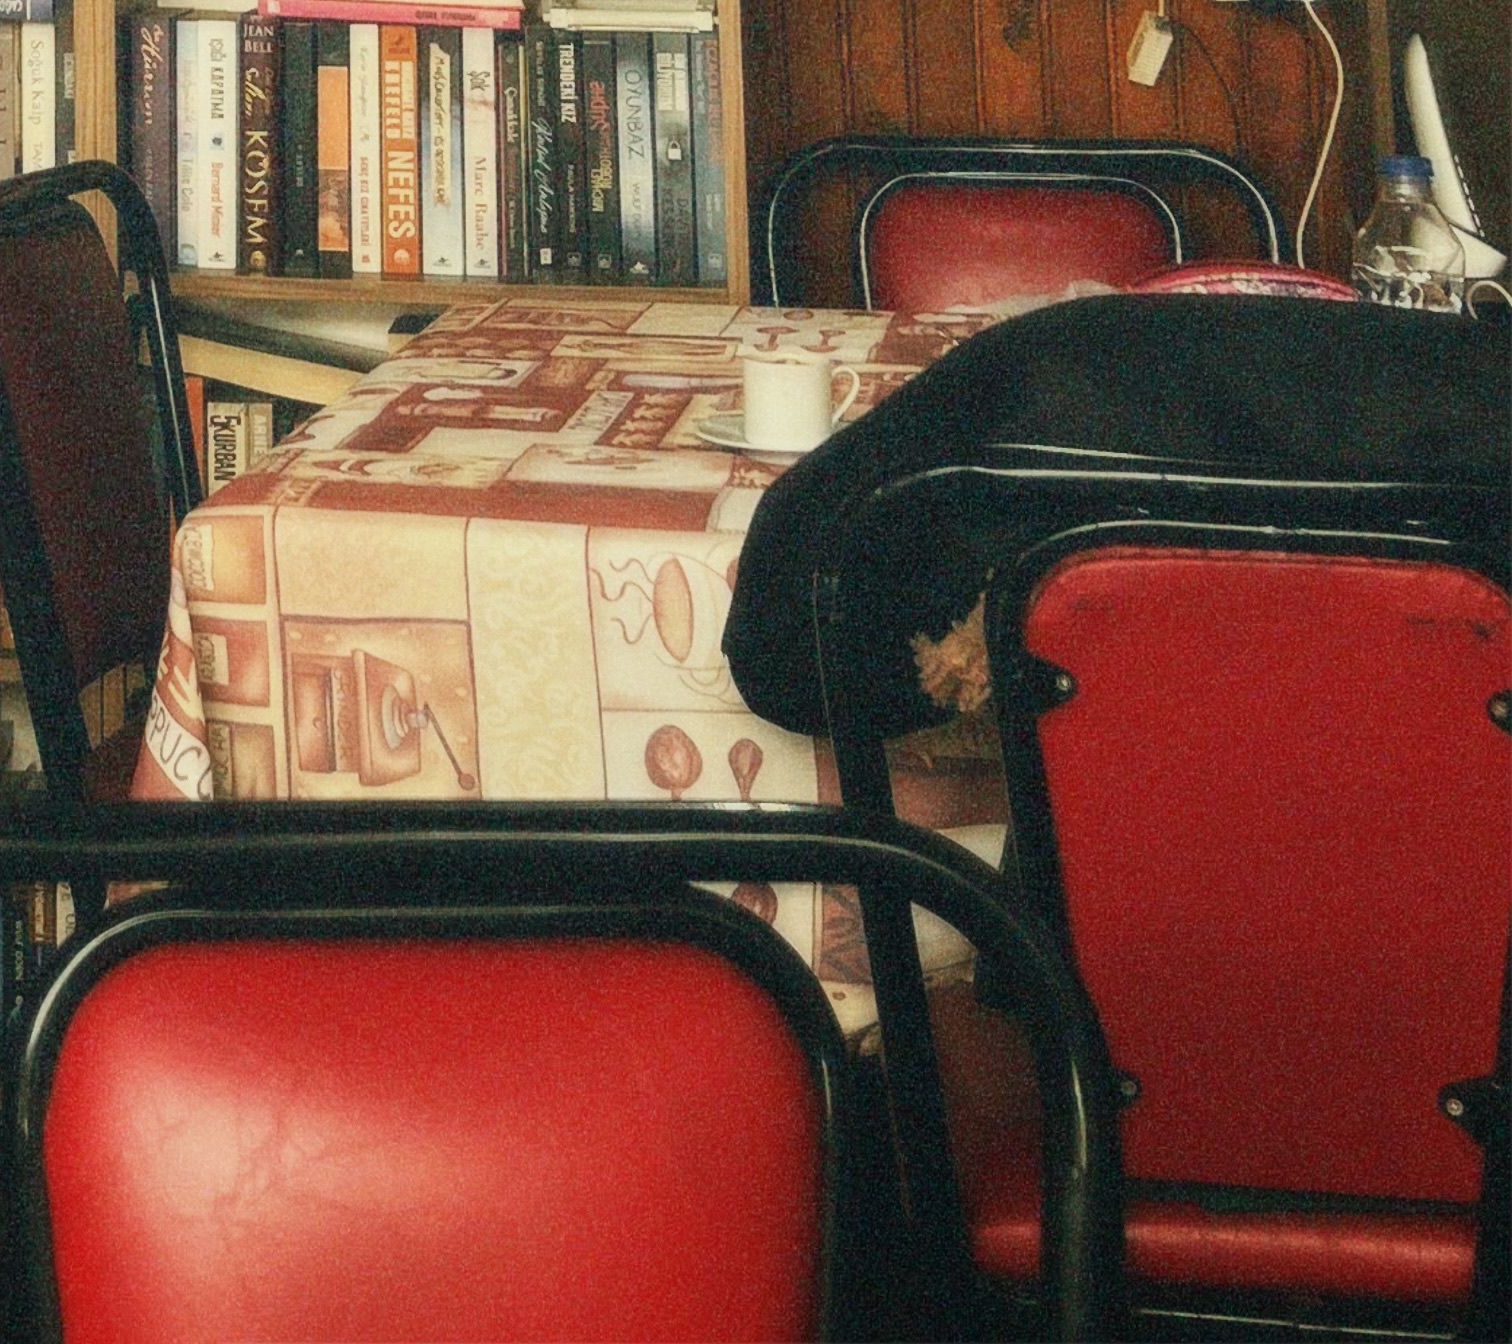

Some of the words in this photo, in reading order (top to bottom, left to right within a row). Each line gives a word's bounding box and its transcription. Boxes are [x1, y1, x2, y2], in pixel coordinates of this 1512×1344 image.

[244, 23, 274, 38] JEAN
[244, 39, 274, 54] BELL
[27, 39, 45, 85] Soğuk
[466, 70, 491, 92] Şok
[559, 43, 579, 100] TRENDEKİ
[28, 89, 45, 126] Kalp
[560, 102, 577, 123] KIZ
[624, 69, 645, 161] OYUNBAZ
[388, 150, 414, 238] NEFES
[474, 156, 488, 196] Marc
[474, 202, 489, 250] Raabe
